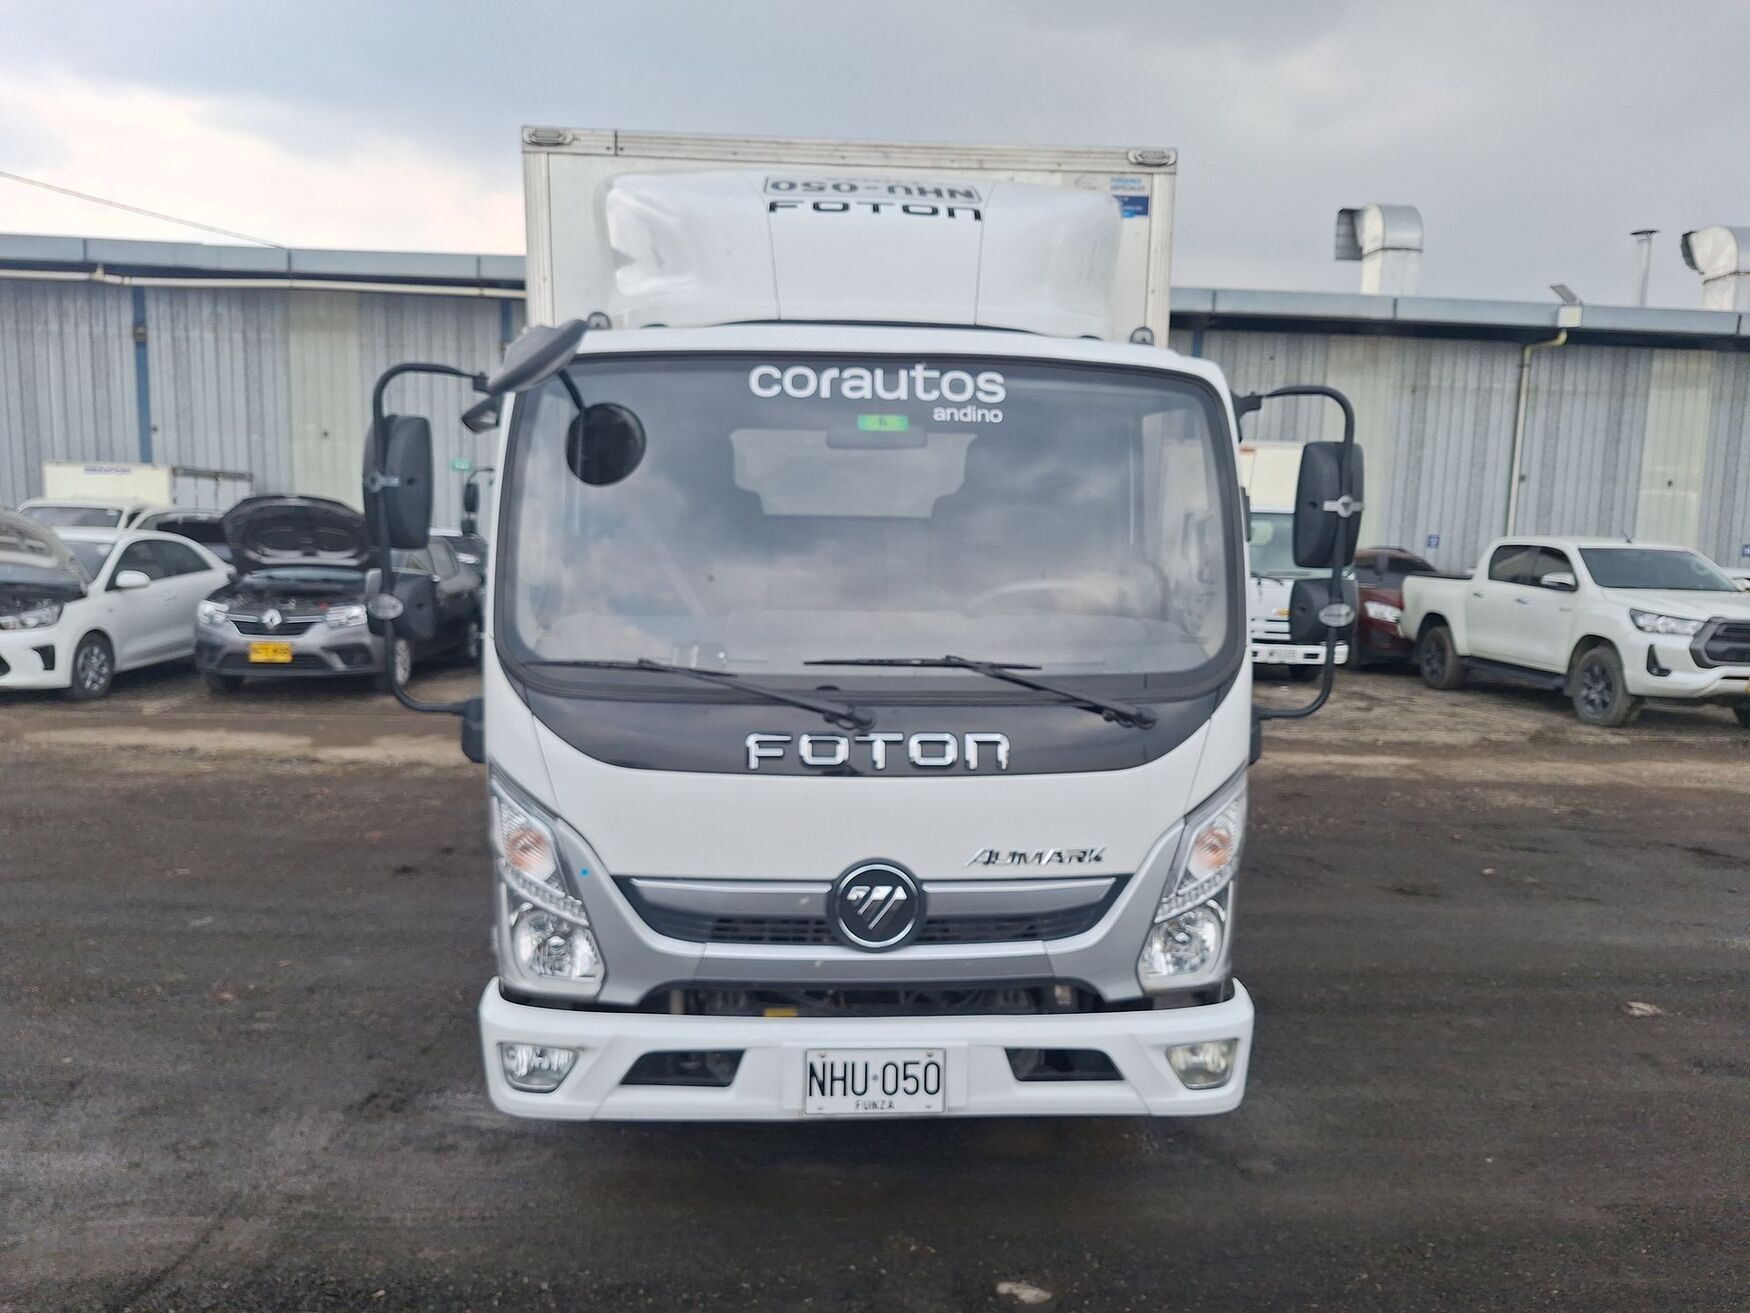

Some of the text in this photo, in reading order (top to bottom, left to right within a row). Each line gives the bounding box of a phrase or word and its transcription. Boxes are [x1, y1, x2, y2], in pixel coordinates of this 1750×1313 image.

[769, 200, 982, 221] FOTON
[749, 363, 1006, 403] corautos
[933, 406, 1004, 423] andino
[745, 733, 1010, 770] FOTON
[966, 847, 1106, 867] AUMARK
[856, 1100, 894, 1110] FUNZA
